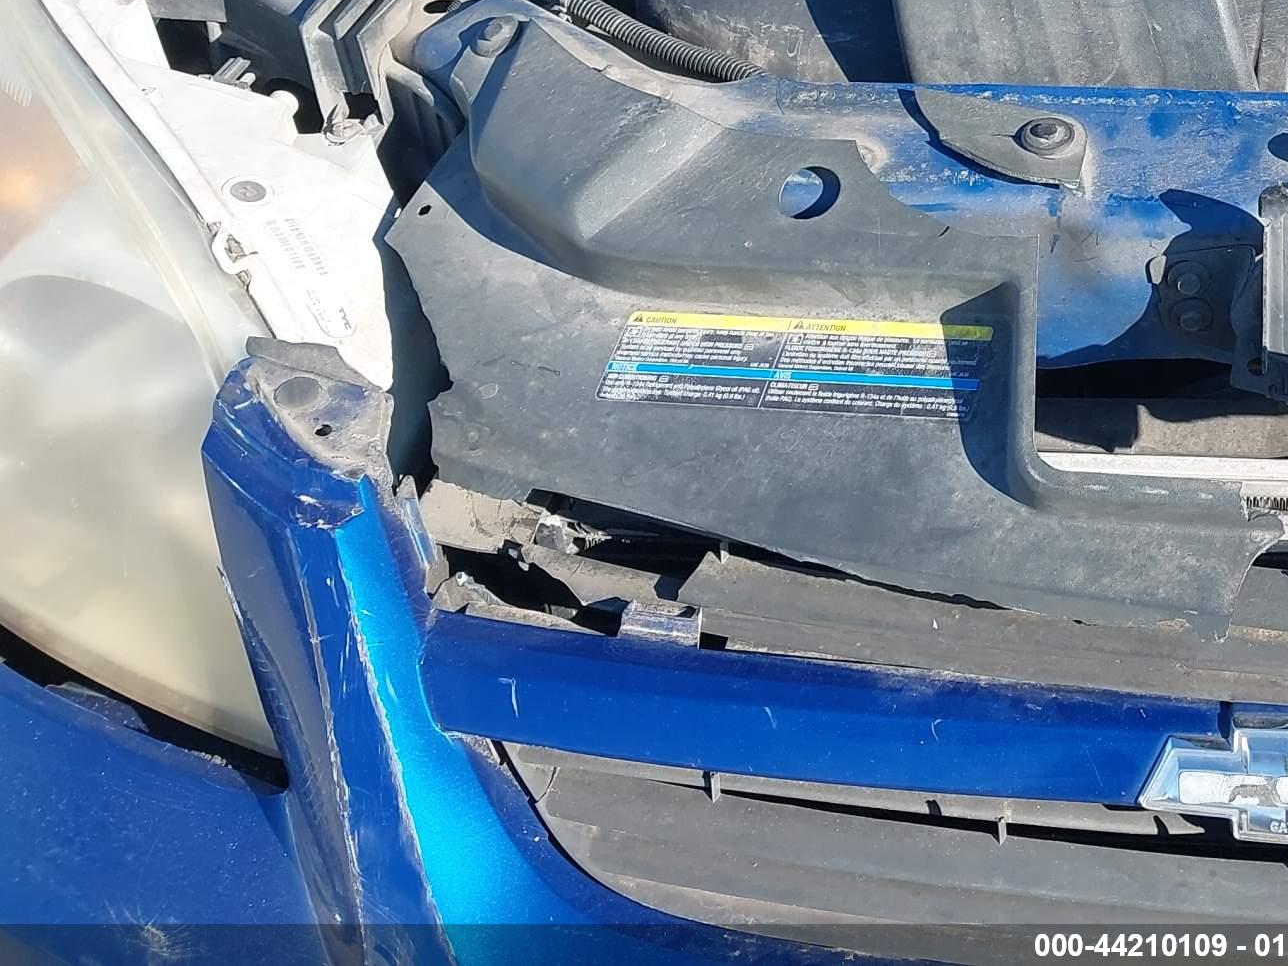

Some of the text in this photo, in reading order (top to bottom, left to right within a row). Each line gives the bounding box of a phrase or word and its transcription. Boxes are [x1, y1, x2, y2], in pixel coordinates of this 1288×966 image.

[645, 316, 678, 325] CAUTION
[805, 323, 847, 332] ATTENTION
[773, 371, 793, 380] AVIS
